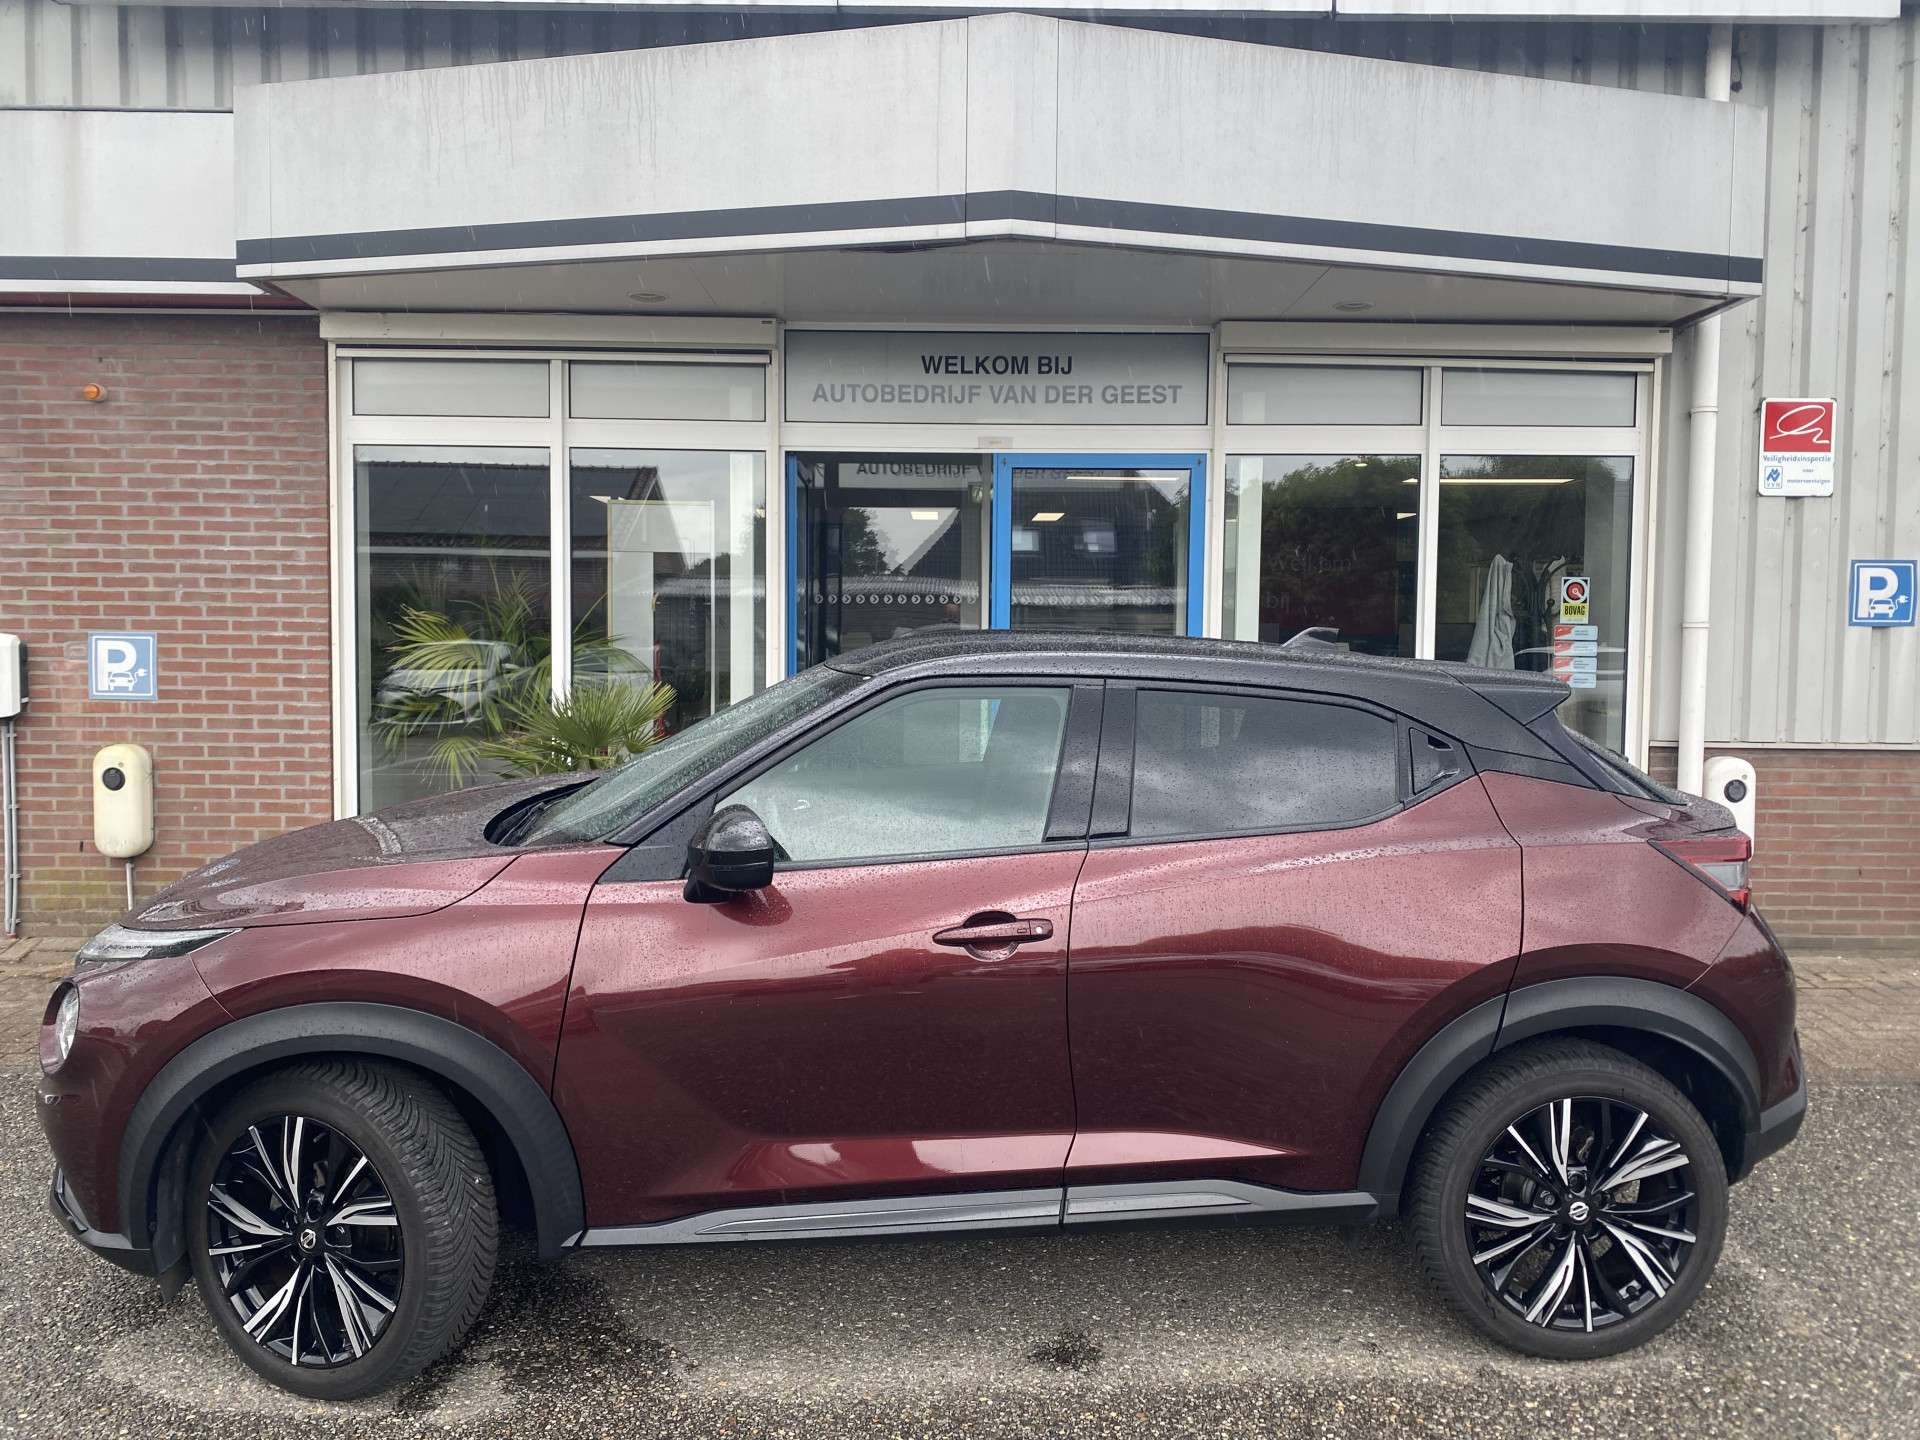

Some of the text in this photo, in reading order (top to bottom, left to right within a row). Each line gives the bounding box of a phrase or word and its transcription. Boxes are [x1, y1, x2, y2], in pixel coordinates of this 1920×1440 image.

[920, 355, 1073, 375] WELKOM BIJ
[811, 383, 1183, 405] AUTOBEDRIJF VAN DER GEEST
[1763, 454, 1831, 463] Veiligheidsinspectie
[1857, 567, 1899, 618] P
[1564, 605, 1586, 616] BOVAG
[97, 640, 137, 691] P
